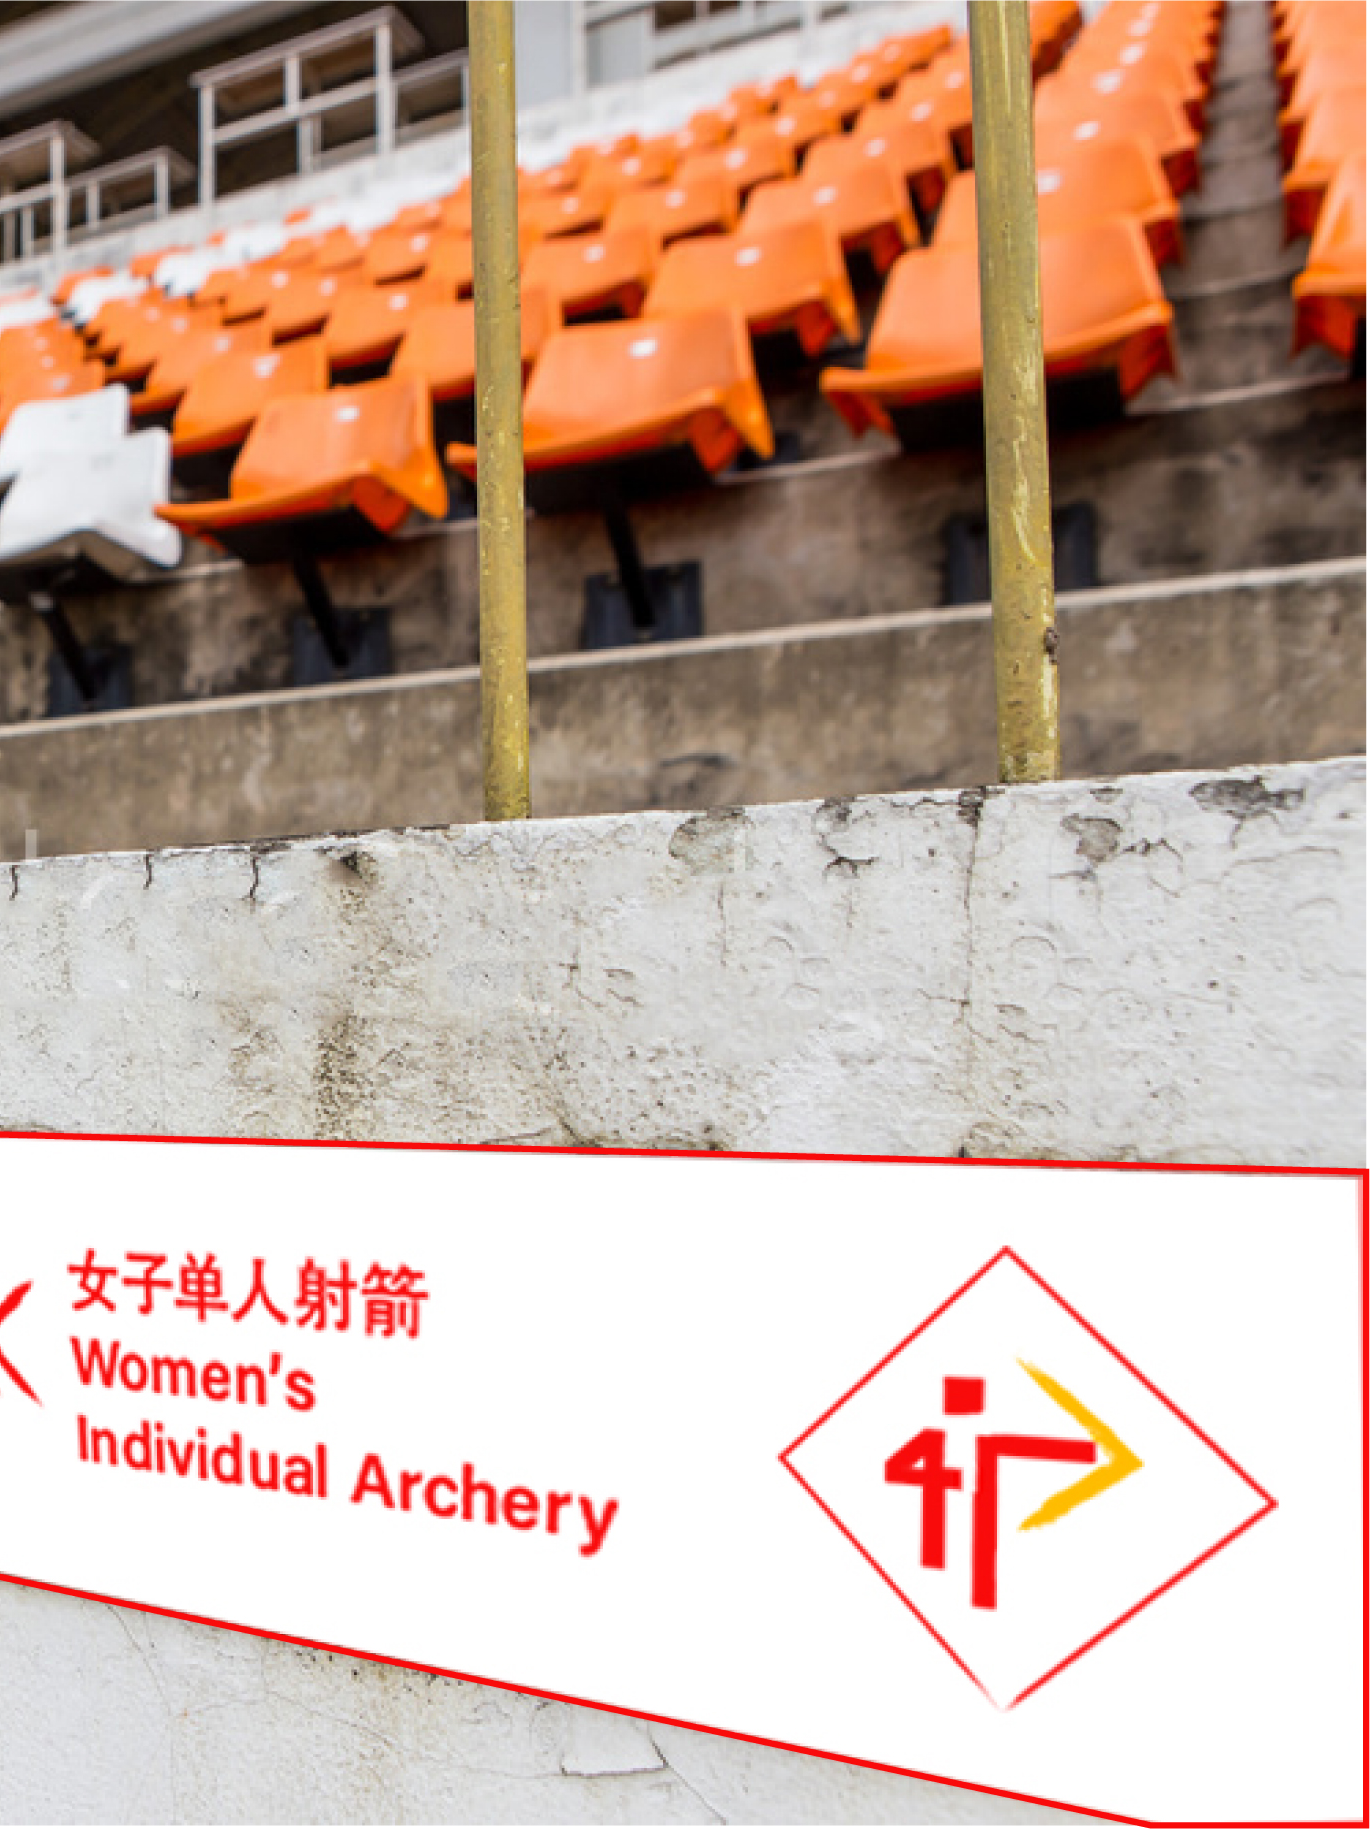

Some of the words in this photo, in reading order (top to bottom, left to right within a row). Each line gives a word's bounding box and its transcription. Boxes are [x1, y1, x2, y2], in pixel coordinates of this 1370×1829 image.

[66, 1247, 429, 1340] 女子单人射箭
[69, 1335, 316, 1413] Women's
[76, 1414, 328, 1498] Individual
[350, 1452, 620, 1558] Archery
